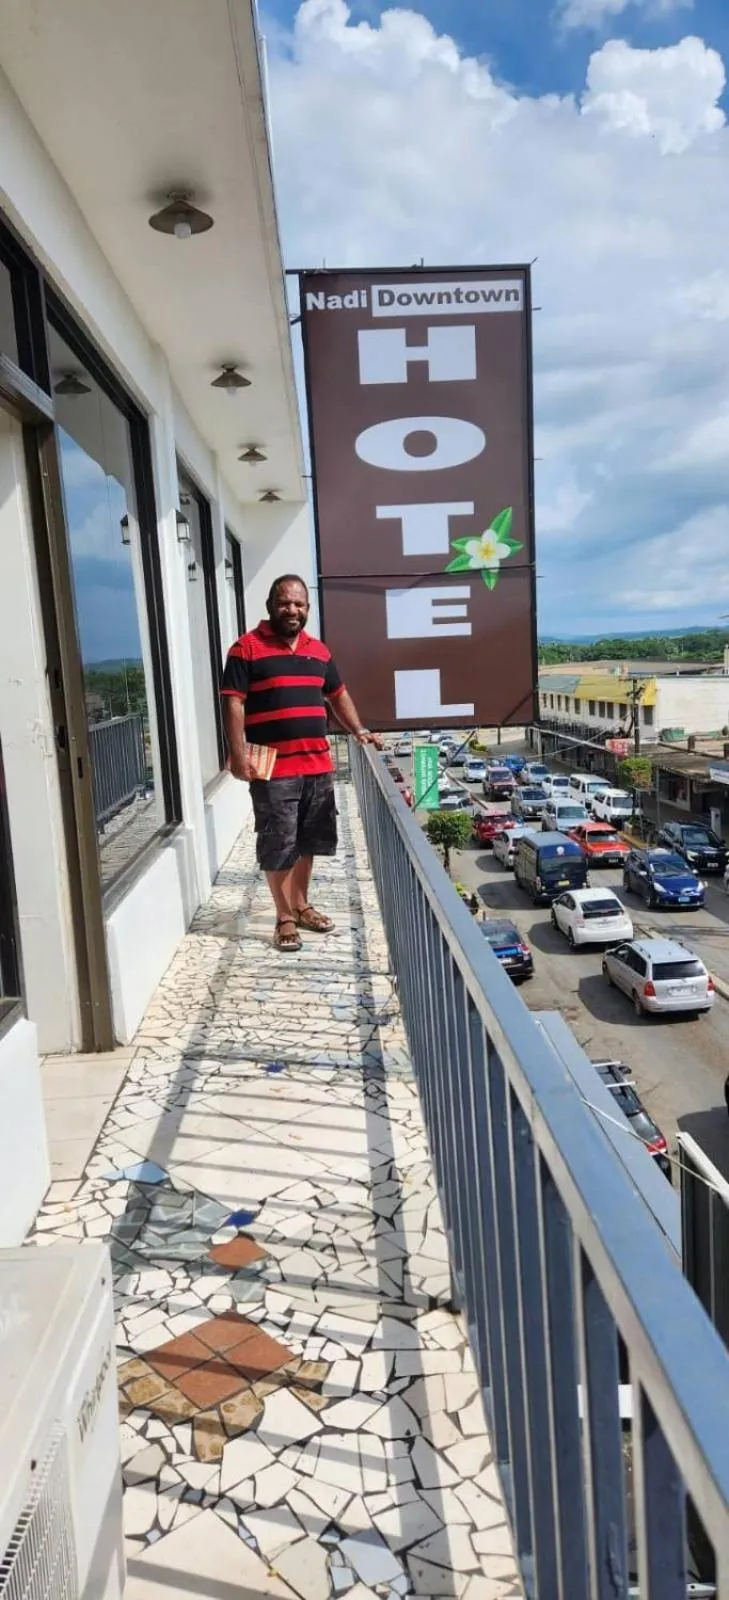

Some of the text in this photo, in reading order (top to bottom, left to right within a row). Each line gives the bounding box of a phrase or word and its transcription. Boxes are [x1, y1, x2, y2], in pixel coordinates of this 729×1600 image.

[306, 286, 520, 311] Nadi Downtown
[355, 324, 486, 719] HOTEL
